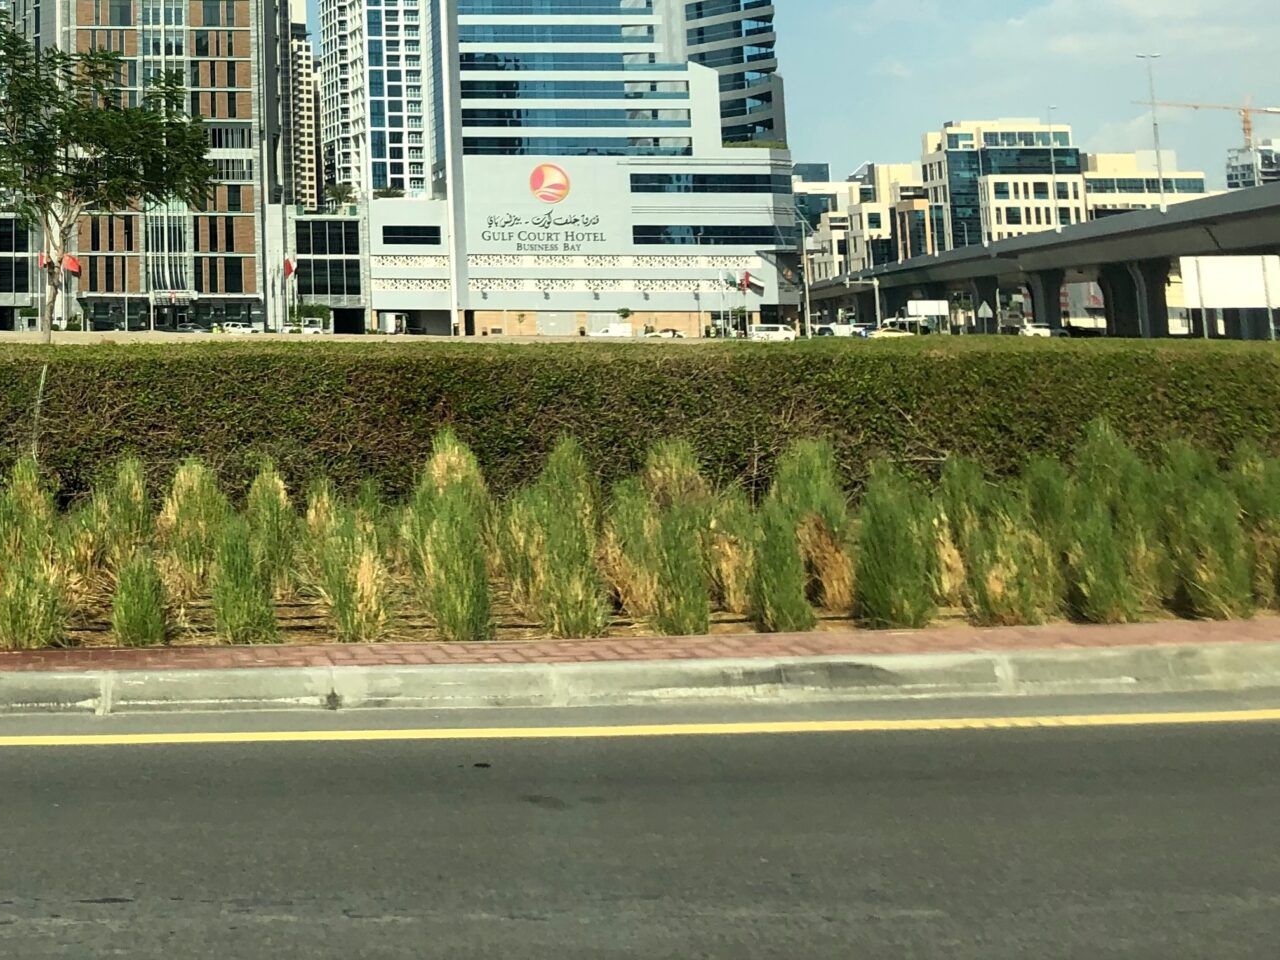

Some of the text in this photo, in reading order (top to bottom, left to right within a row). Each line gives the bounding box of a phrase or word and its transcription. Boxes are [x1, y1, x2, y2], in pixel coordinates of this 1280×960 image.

[481, 230, 607, 242] GULF COURT HOTEL
[516, 243, 582, 252] BUSINESS BAY
